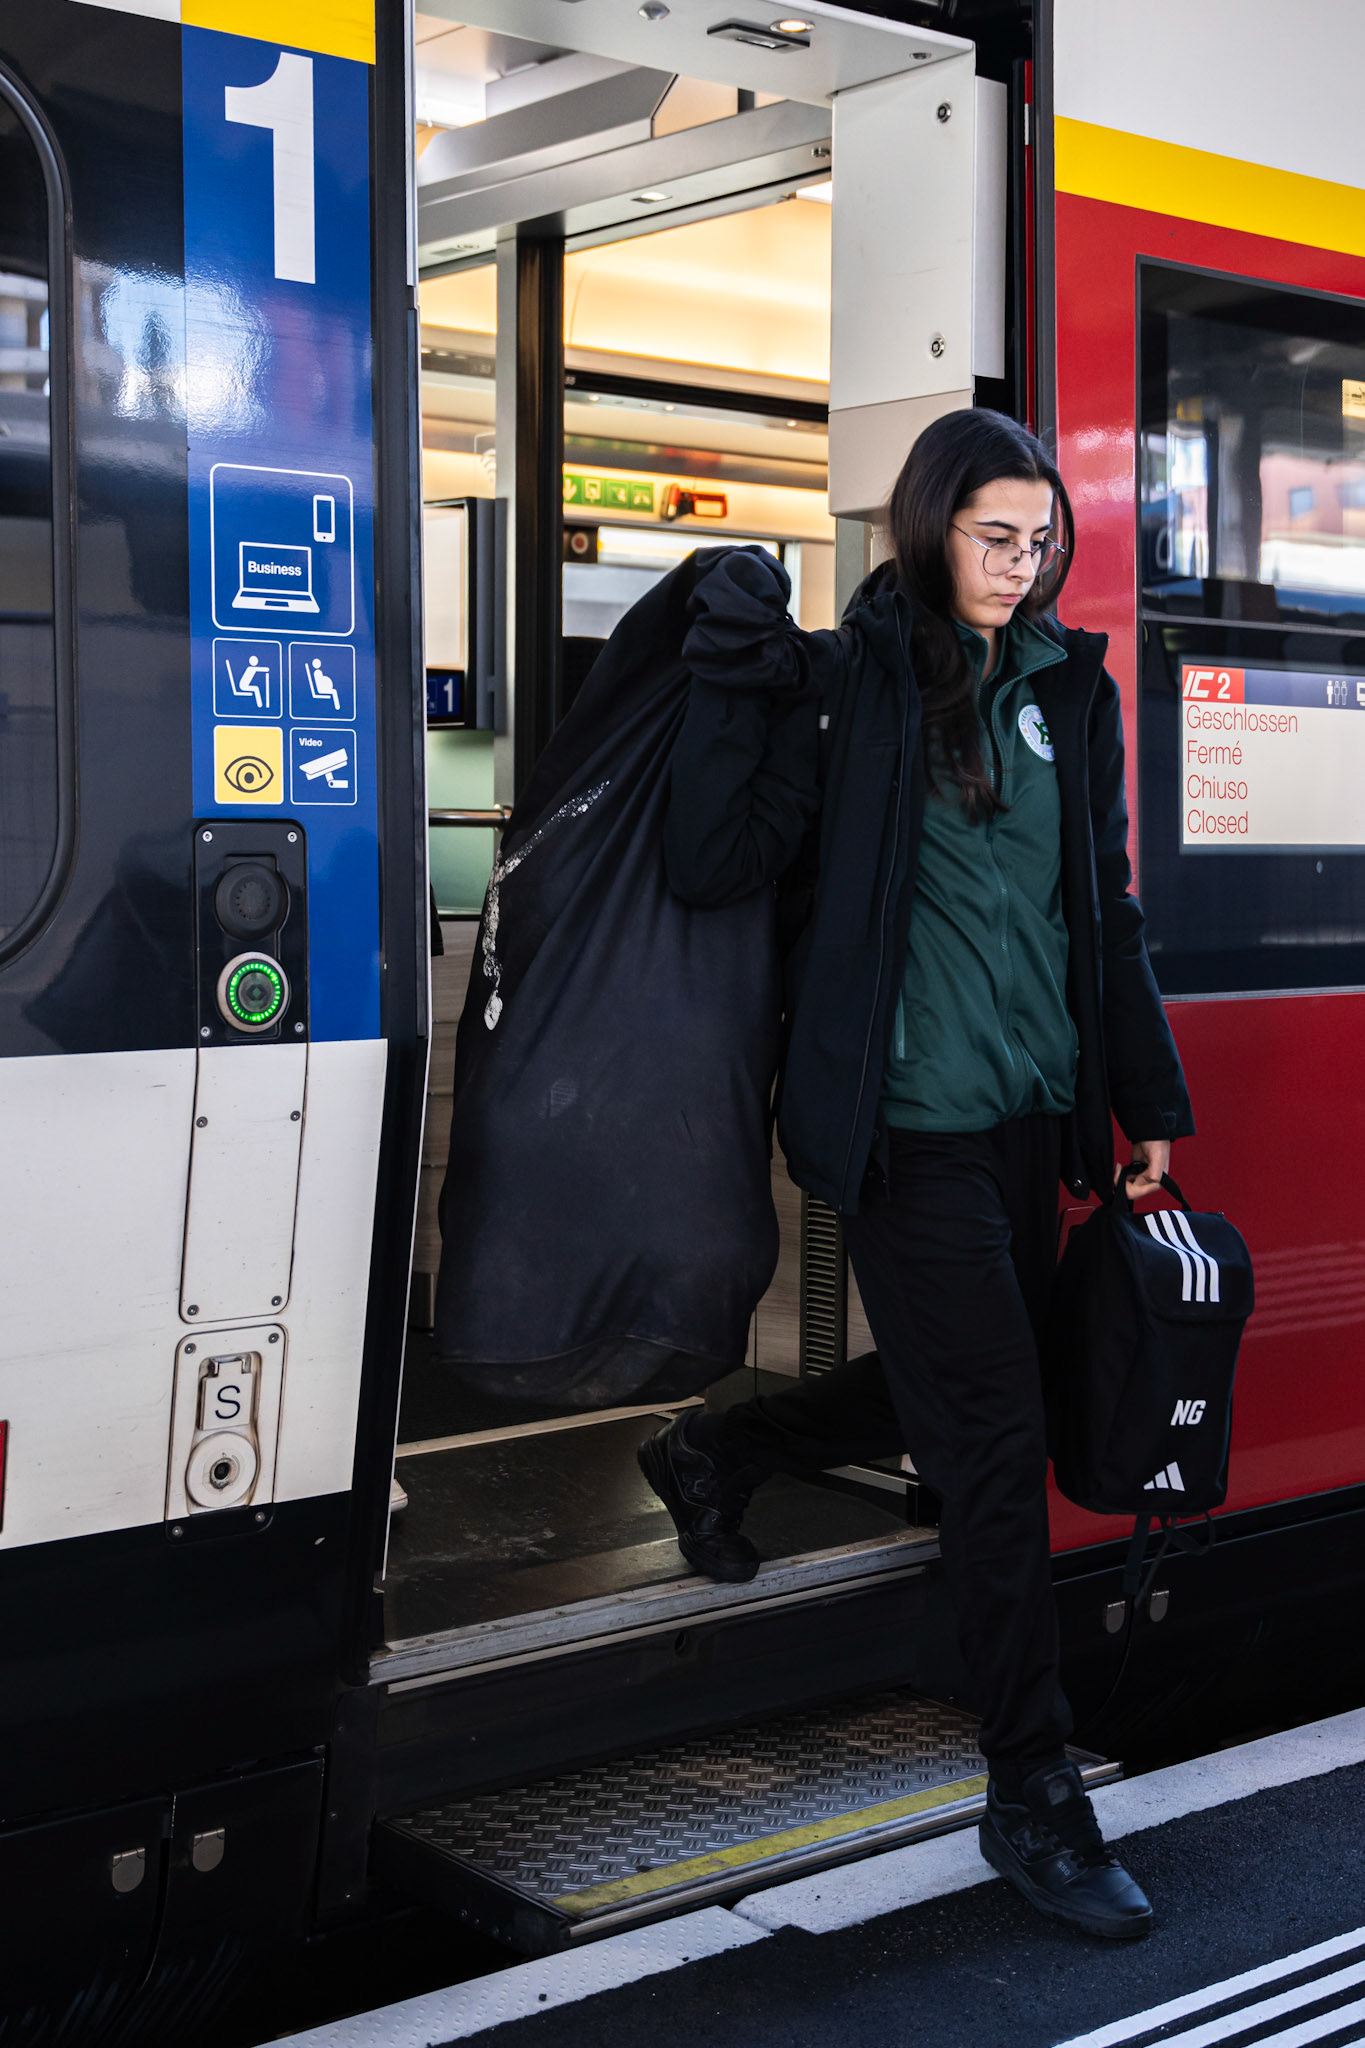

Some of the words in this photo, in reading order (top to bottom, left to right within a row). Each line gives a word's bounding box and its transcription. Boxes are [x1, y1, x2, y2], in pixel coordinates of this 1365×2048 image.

[224, 51, 316, 284] 1
[247, 560, 302, 577] Business
[443, 678, 453, 713] 1
[1183, 670, 1215, 698] IC
[1217, 671, 1232, 700] 2
[1186, 704, 1299, 733] Geschlossen
[298, 737, 323, 747] Video
[1187, 739, 1243, 765] Fermé
[1187, 774, 1249, 800] Chiuso
[1187, 809, 1249, 834] Closed
[215, 1385, 241, 1420] S
[1170, 1399, 1207, 1426] NG
